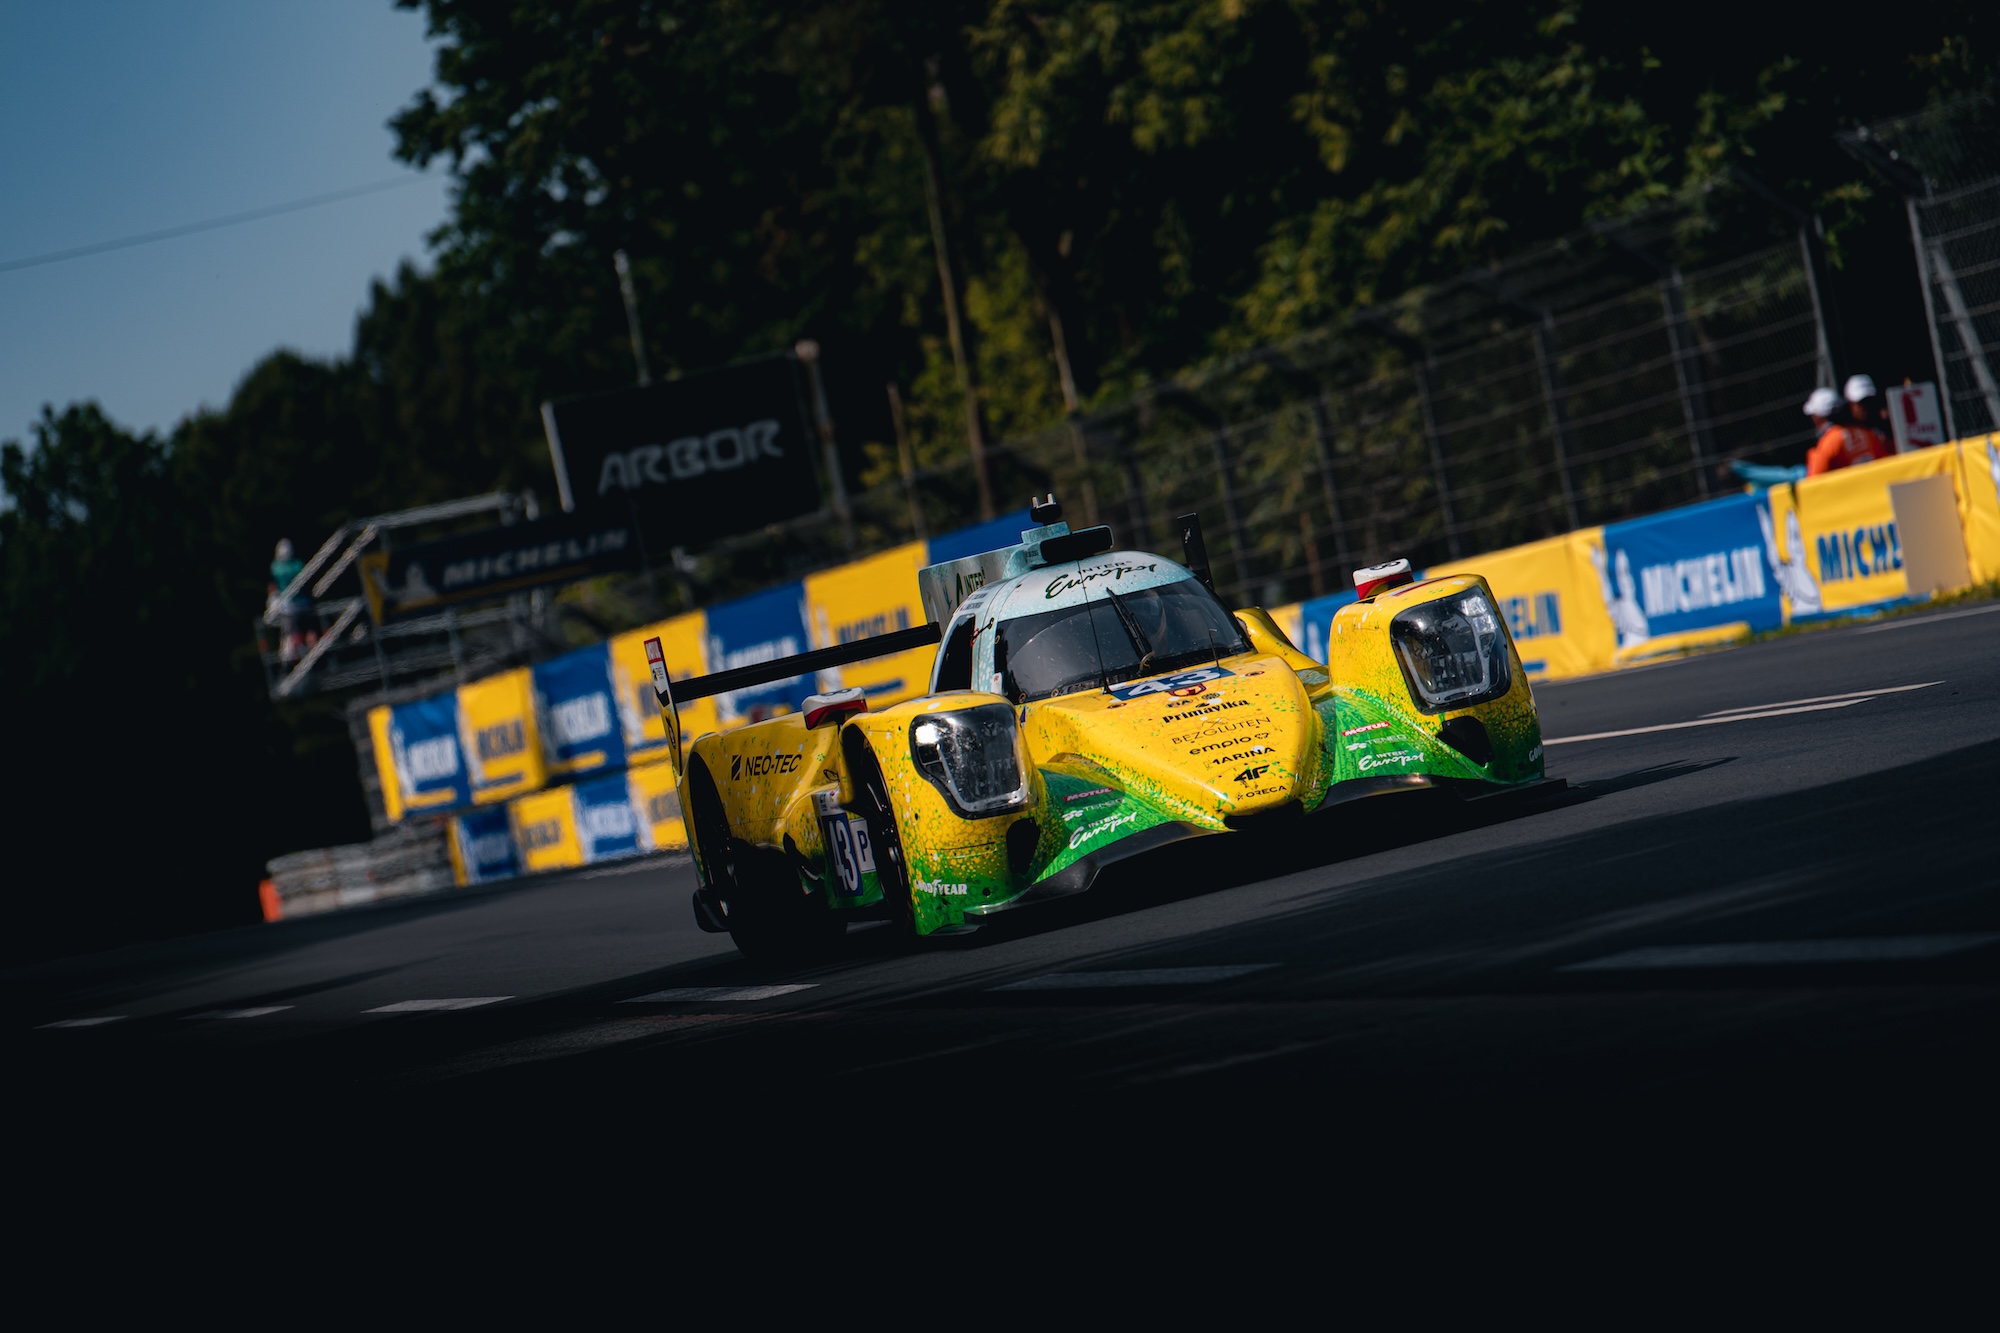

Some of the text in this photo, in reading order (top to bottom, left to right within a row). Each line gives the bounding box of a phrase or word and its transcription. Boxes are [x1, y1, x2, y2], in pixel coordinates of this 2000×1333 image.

[599, 420, 783, 494] ARBOR
[443, 530, 629, 587] MICHELIN
[1640, 545, 1765, 619] MICHELIN
[1128, 669, 1220, 696] 43
[1162, 699, 1249, 723] Primavika
[1172, 717, 1271, 745] BEZGLUTEN
[1344, 722, 1389, 736] MOTUL
[1189, 736, 1252, 755] emplo
[744, 754, 802, 777] NEO-TEC
[1358, 753, 1424, 771] Europol
[1066, 788, 1112, 801] MOTUL
[1246, 785, 1287, 798] ORECA
[1069, 812, 1137, 850] Europol
[828, 820, 858, 892] 43
[857, 830, 868, 862] P
